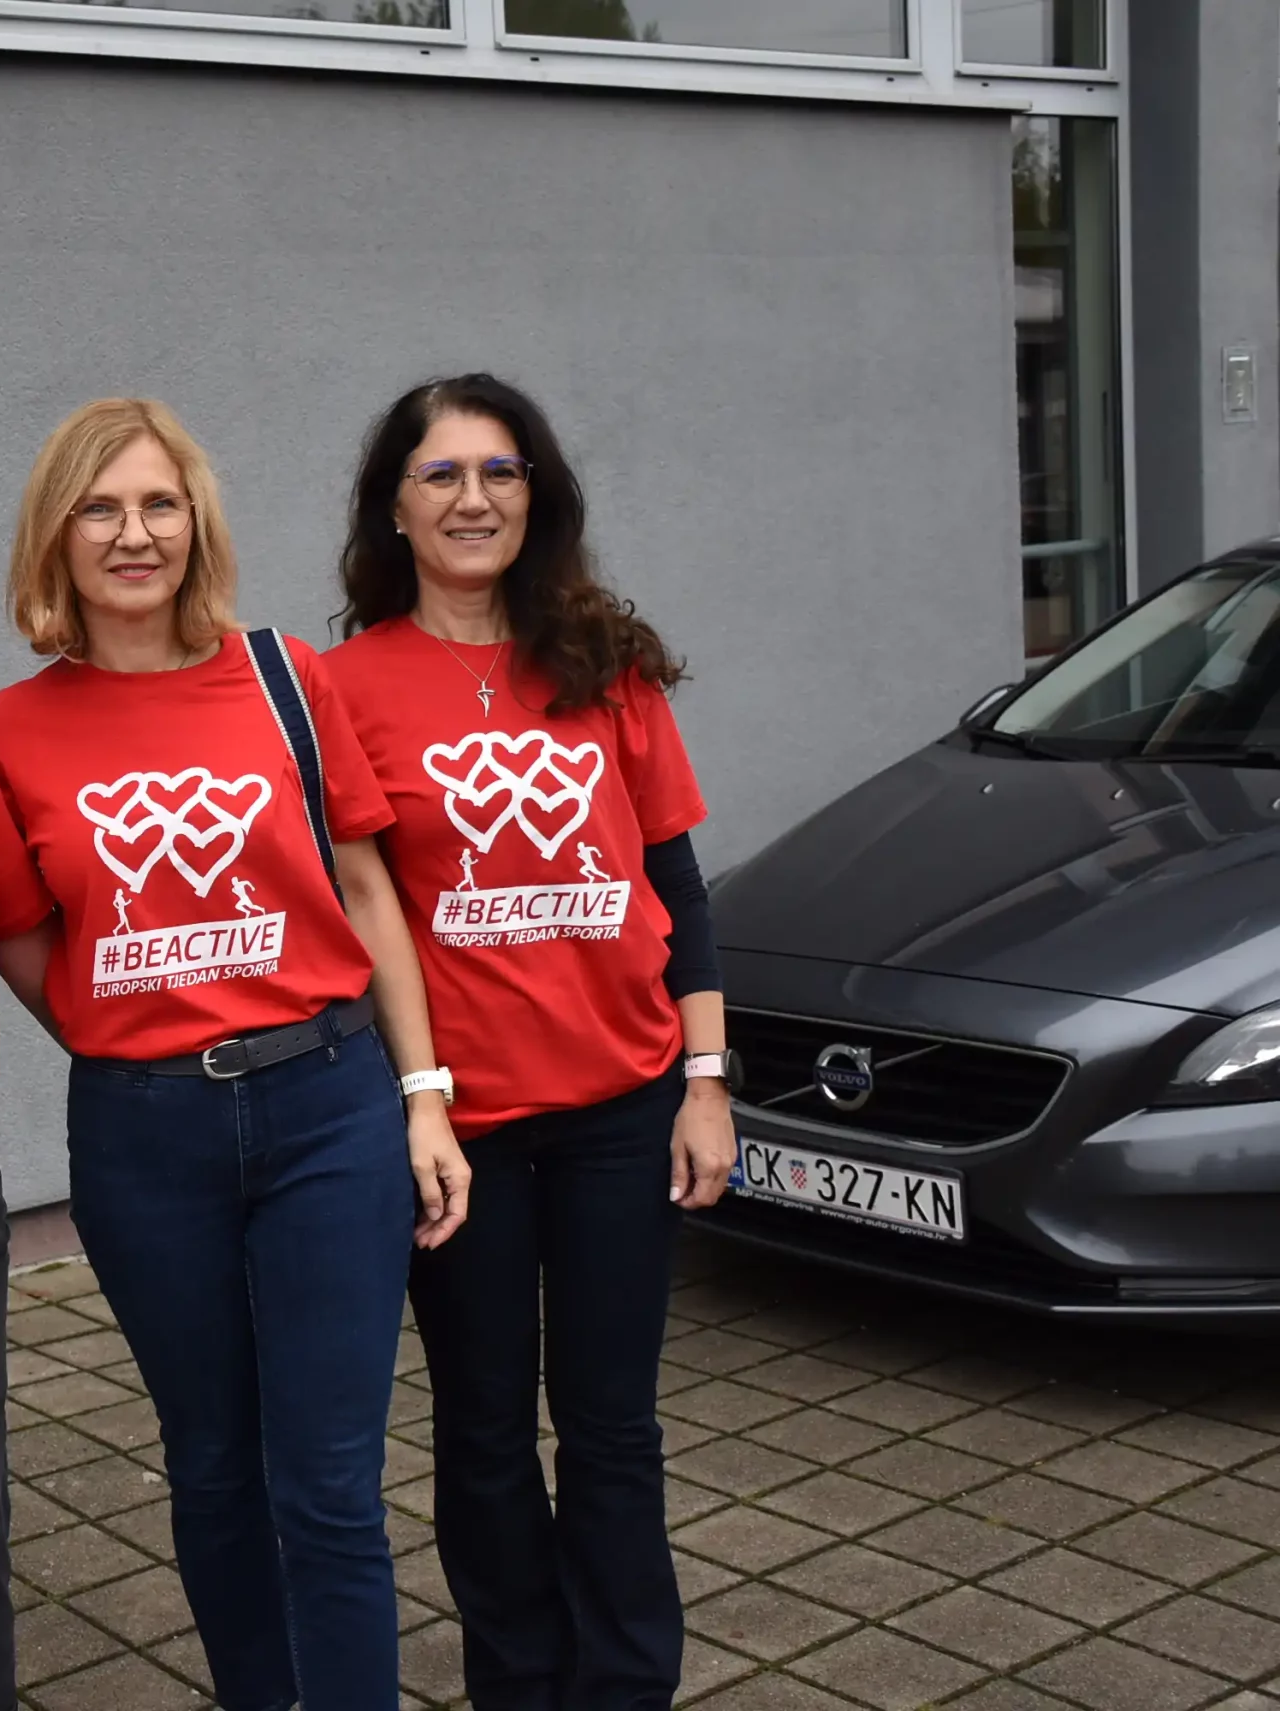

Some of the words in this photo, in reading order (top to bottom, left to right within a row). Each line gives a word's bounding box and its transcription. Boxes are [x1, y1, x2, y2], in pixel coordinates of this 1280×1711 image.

[443, 889, 622, 925] #BEACTIVE
[101, 921, 278, 974] #BEACTIVE
[505, 926, 560, 945] TJEDAN
[561, 925, 621, 940] SPORTA
[93, 977, 162, 999] EUROPSKI
[165, 966, 220, 990] TJEDAN
[221, 959, 279, 980] SPORTA
[818, 1070, 867, 1086] VOLVO
[735, 1187, 753, 1198] MP
[775, 1197, 814, 1212] trgovina
[744, 1143, 787, 1192] ČK
[814, 1158, 957, 1229] 327-KN
